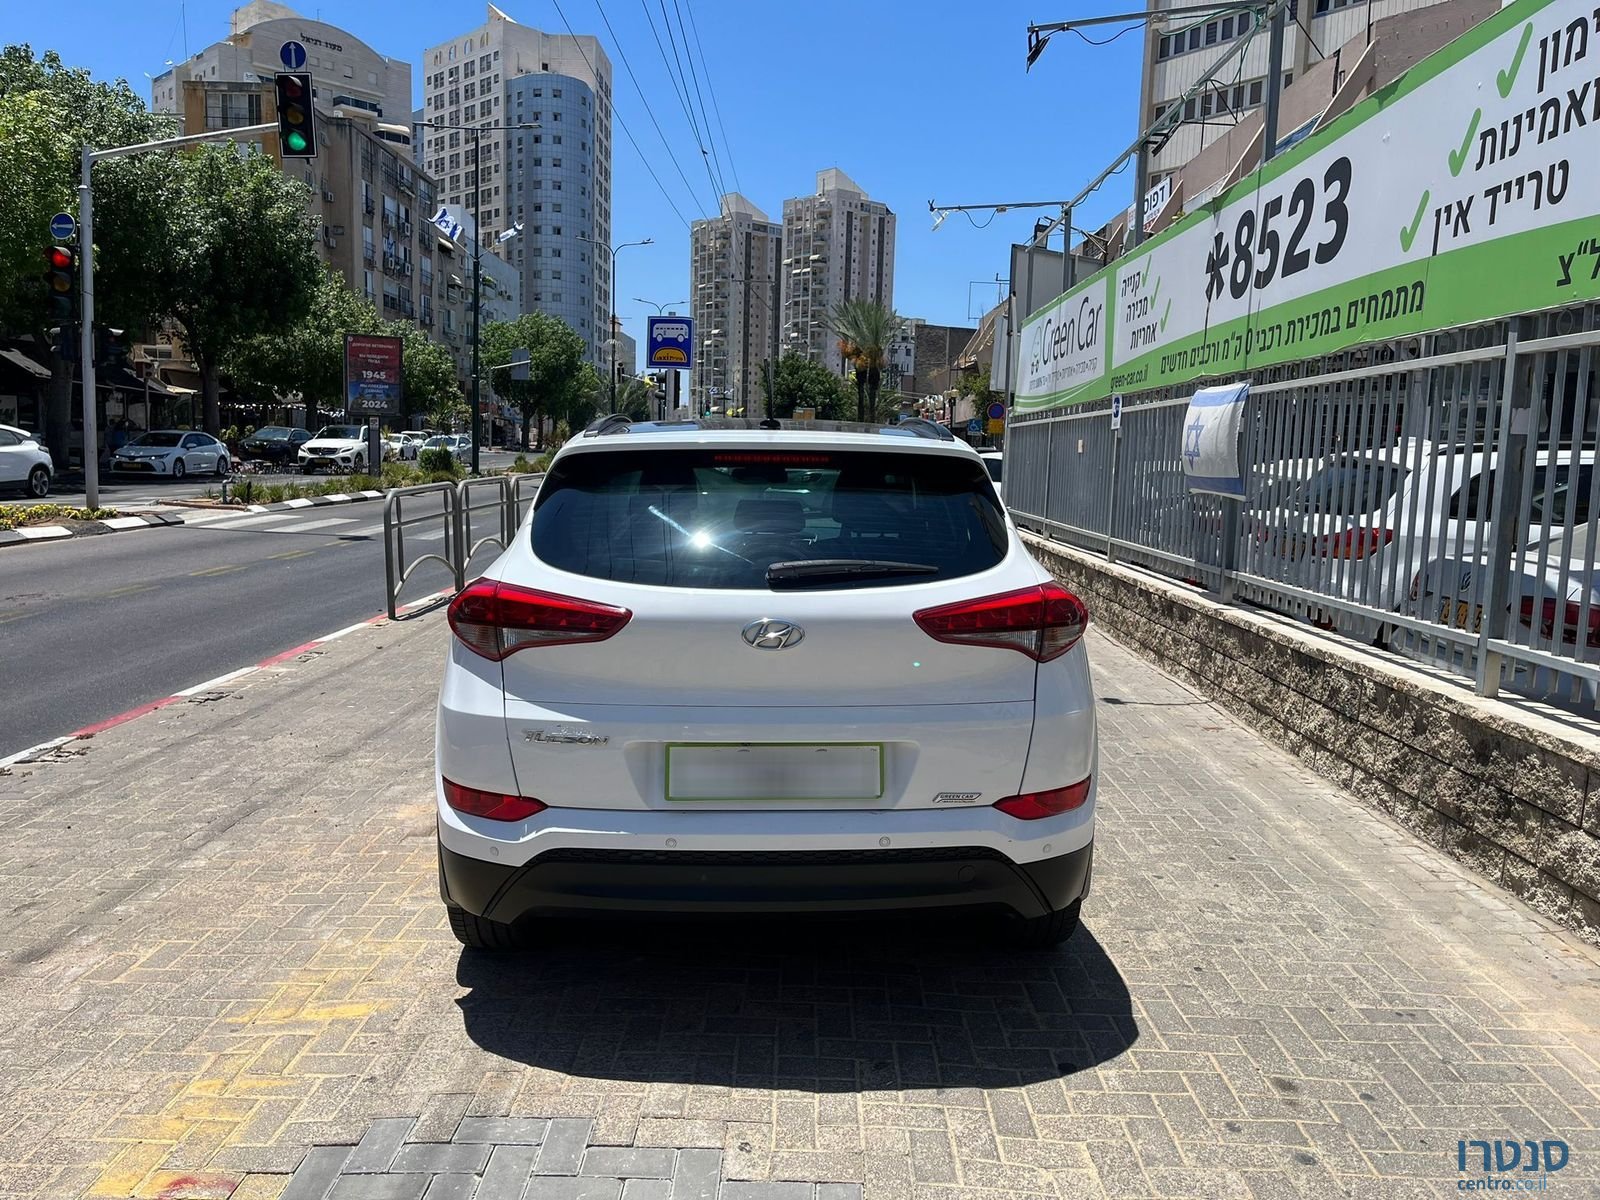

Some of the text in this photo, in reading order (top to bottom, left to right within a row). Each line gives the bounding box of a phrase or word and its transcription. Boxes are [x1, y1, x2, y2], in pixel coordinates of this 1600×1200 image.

[1143, 184, 1165, 215] דפוס
[1432, 159, 1570, 256] טרייד אין
[1121, 271, 1141, 298] קנייה
[1126, 296, 1148, 323] מכירה
[1346, 280, 1425, 330] מתמחים
[1043, 296, 1102, 366] Green Car
[1130, 321, 1158, 351] אחריות
[1256, 323, 1282, 353] רכבי
[1284, 306, 1340, 346] במכירת
[1190, 340, 1220, 367] ורכבים
[1221, 332, 1241, 361] ק"מ
[362, 370, 386, 379] 1945
[1110, 362, 1149, 393] green-car.co.il
[1160, 350, 1187, 375] חדשים
[362, 400, 388, 409] 2024
